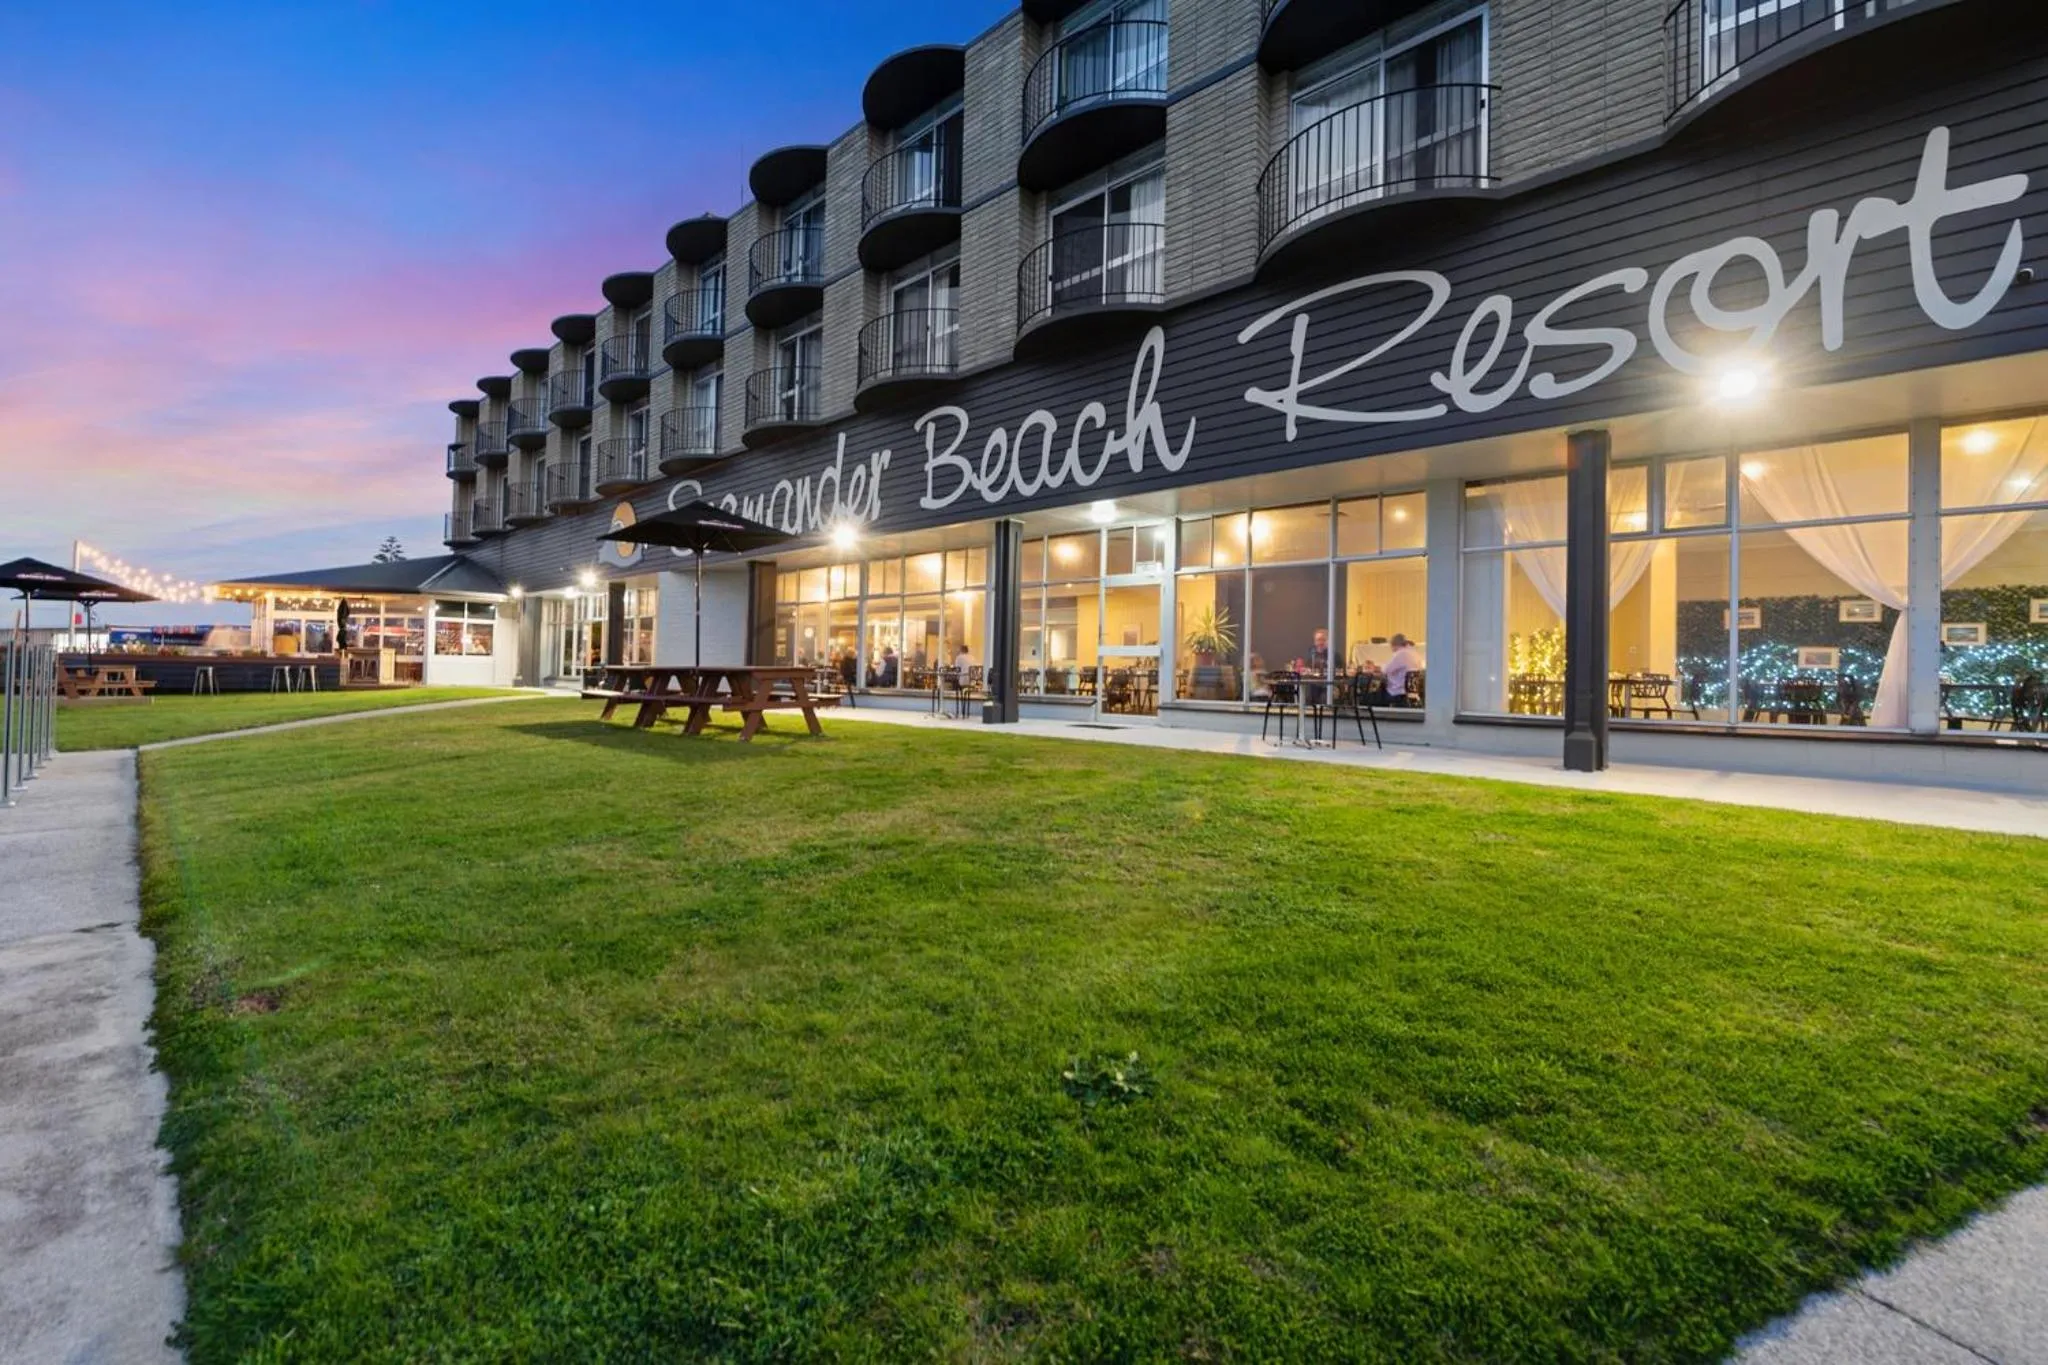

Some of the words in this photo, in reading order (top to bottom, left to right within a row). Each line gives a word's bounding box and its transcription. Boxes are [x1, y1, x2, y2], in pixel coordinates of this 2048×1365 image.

[666, 432, 892, 557] Smander
[914, 325, 1196, 510] Beach
[1237, 125, 2030, 442] Resort
